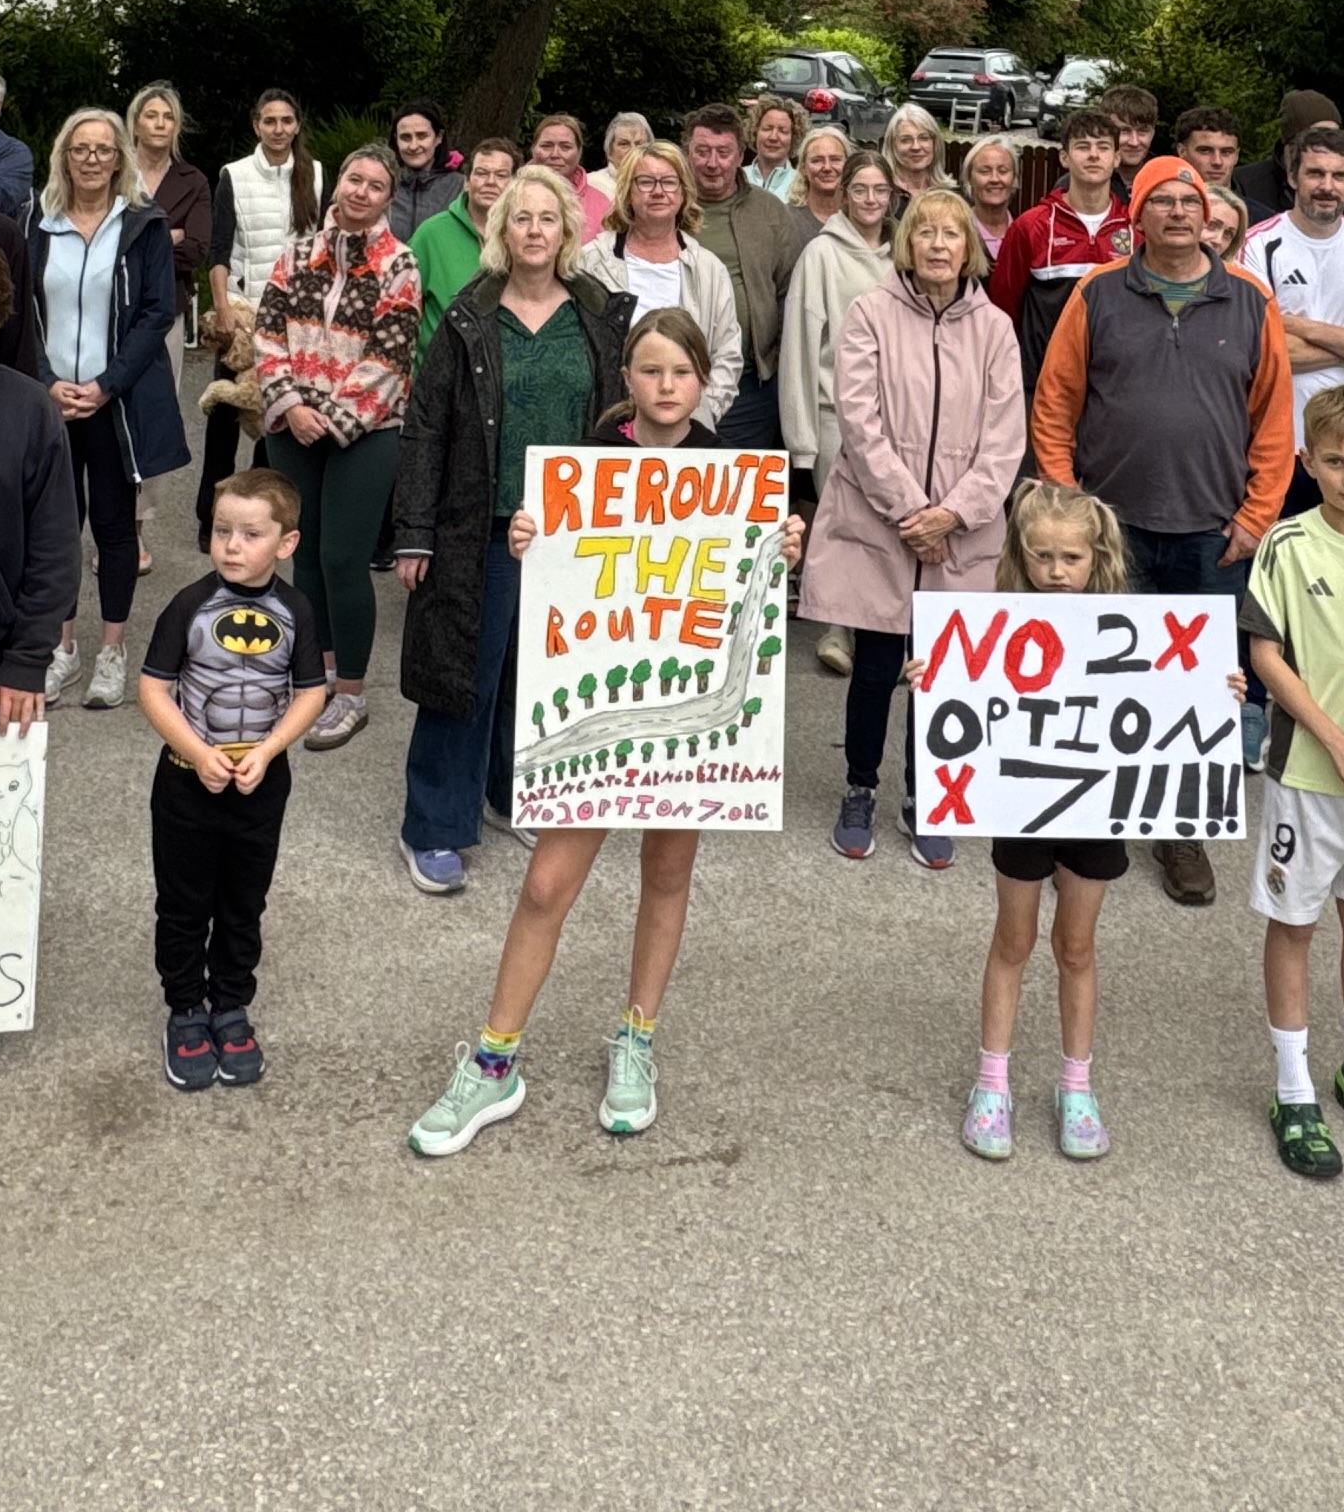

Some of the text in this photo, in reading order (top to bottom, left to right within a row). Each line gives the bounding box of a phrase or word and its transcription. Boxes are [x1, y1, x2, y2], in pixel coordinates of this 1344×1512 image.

[542, 454, 786, 536] REROUTE
[574, 535, 732, 601] THE
[545, 596, 729, 658] ROUTE
[920, 608, 1065, 694] NO
[926, 695, 1237, 760] OPTION
[517, 780, 586, 807] SAYING
[1270, 822, 1296, 864] 9
